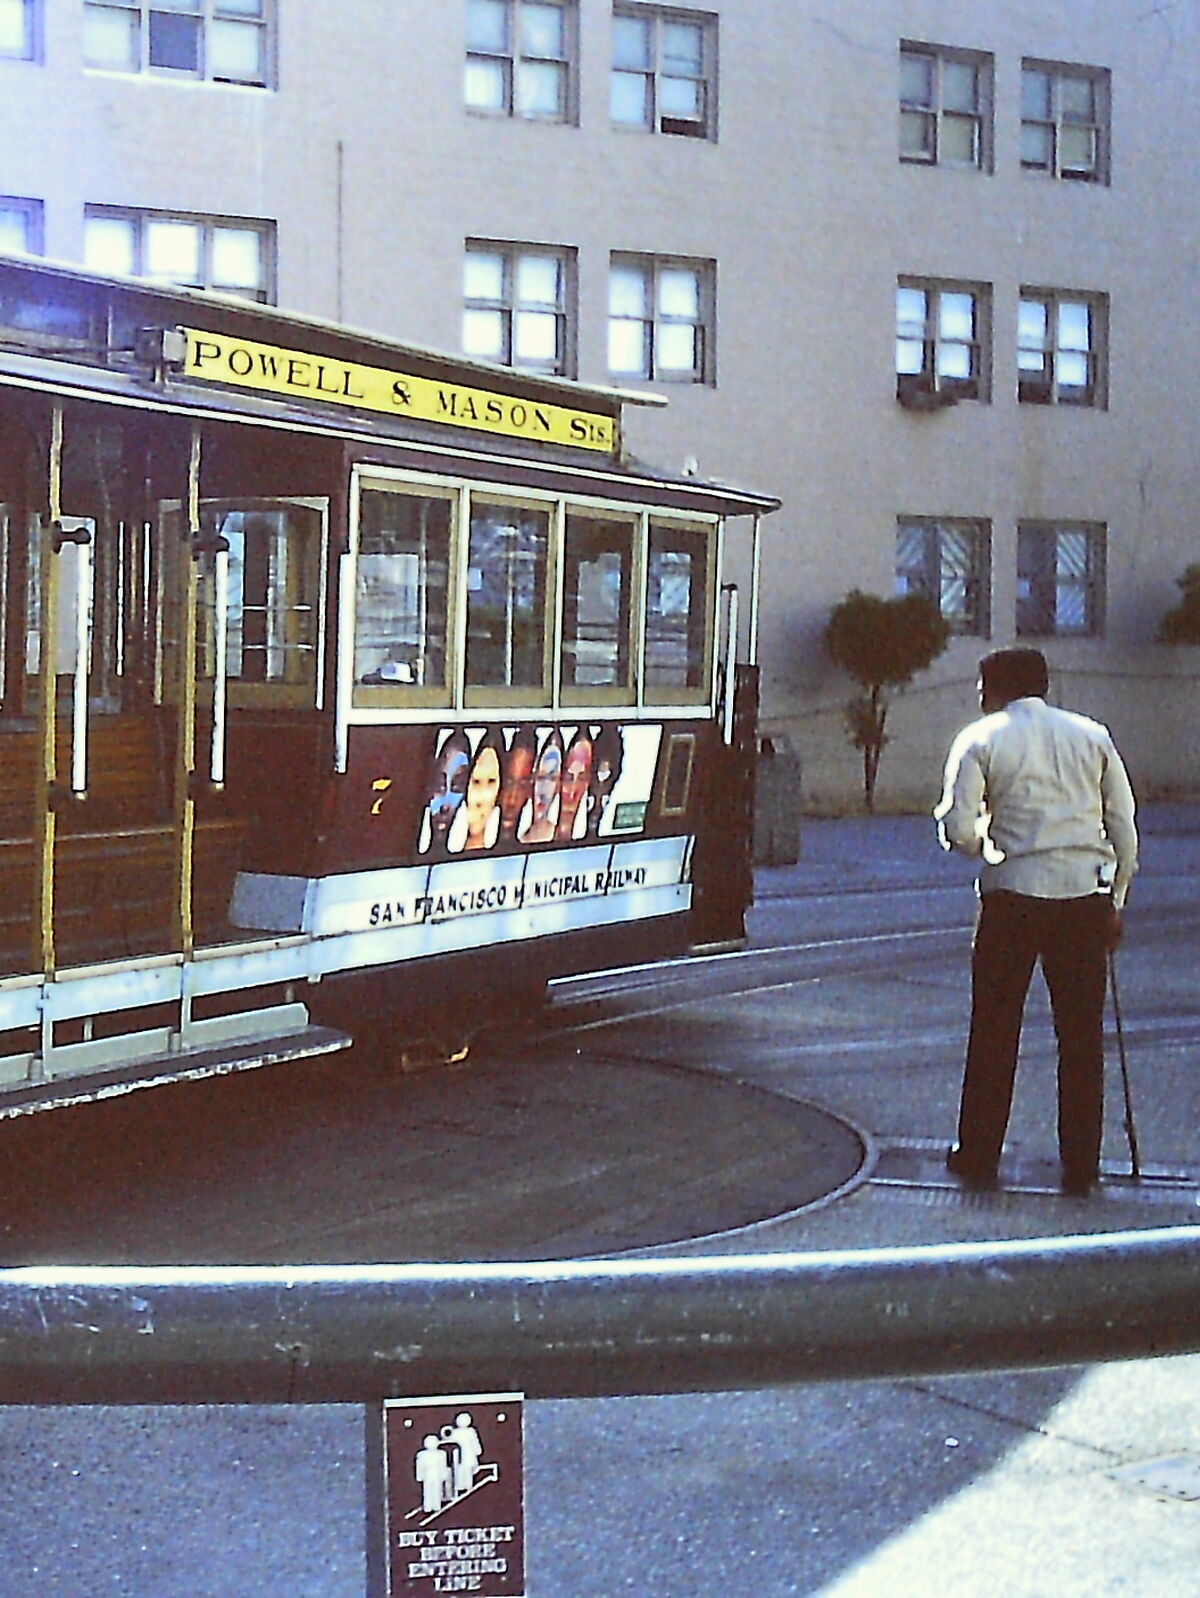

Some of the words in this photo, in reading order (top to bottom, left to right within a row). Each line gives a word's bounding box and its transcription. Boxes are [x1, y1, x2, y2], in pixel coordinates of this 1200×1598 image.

[192, 340, 364, 399] POWELL
[391, 380, 411, 407] &
[437, 390, 551, 432] MASON
[371, 777, 394, 815] 7
[369, 901, 405, 926] SAN
[514, 874, 590, 904] MNICIPAL
[398, 1529, 439, 1548] BUY
[443, 1524, 516, 1545] TICKET
[420, 1542, 497, 1562] BEFORE
[407, 1557, 508, 1578] ENTERING
[434, 1574, 482, 1592] LINE
